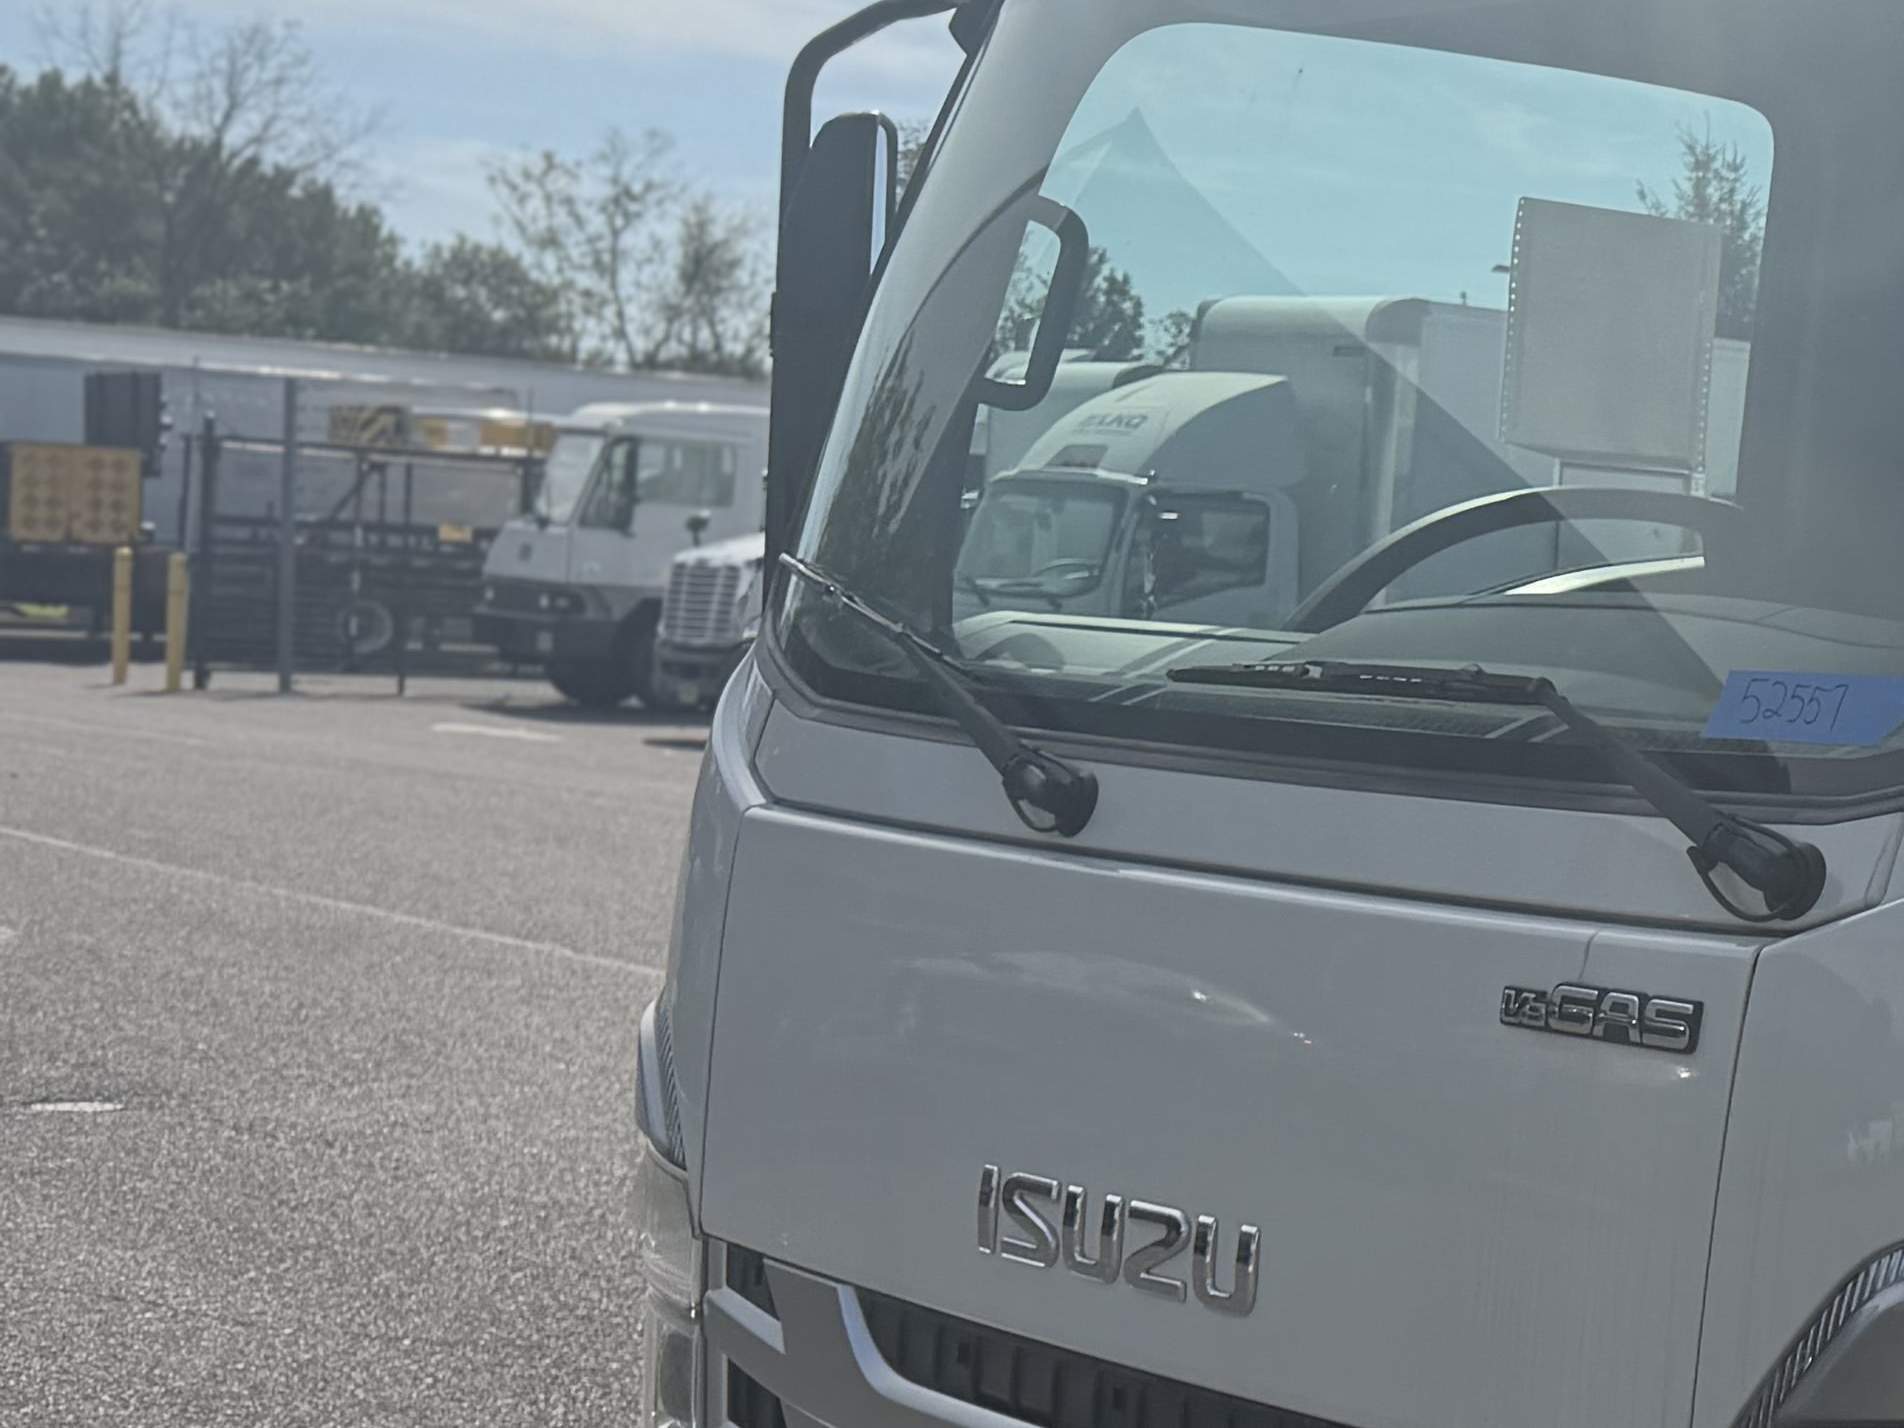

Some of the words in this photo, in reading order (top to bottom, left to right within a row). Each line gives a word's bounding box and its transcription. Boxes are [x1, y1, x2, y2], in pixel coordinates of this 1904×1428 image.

[1739, 677, 1849, 732] 52557
[1549, 984, 1694, 1051] GAS
[976, 1163, 1261, 1319] ISUZU
